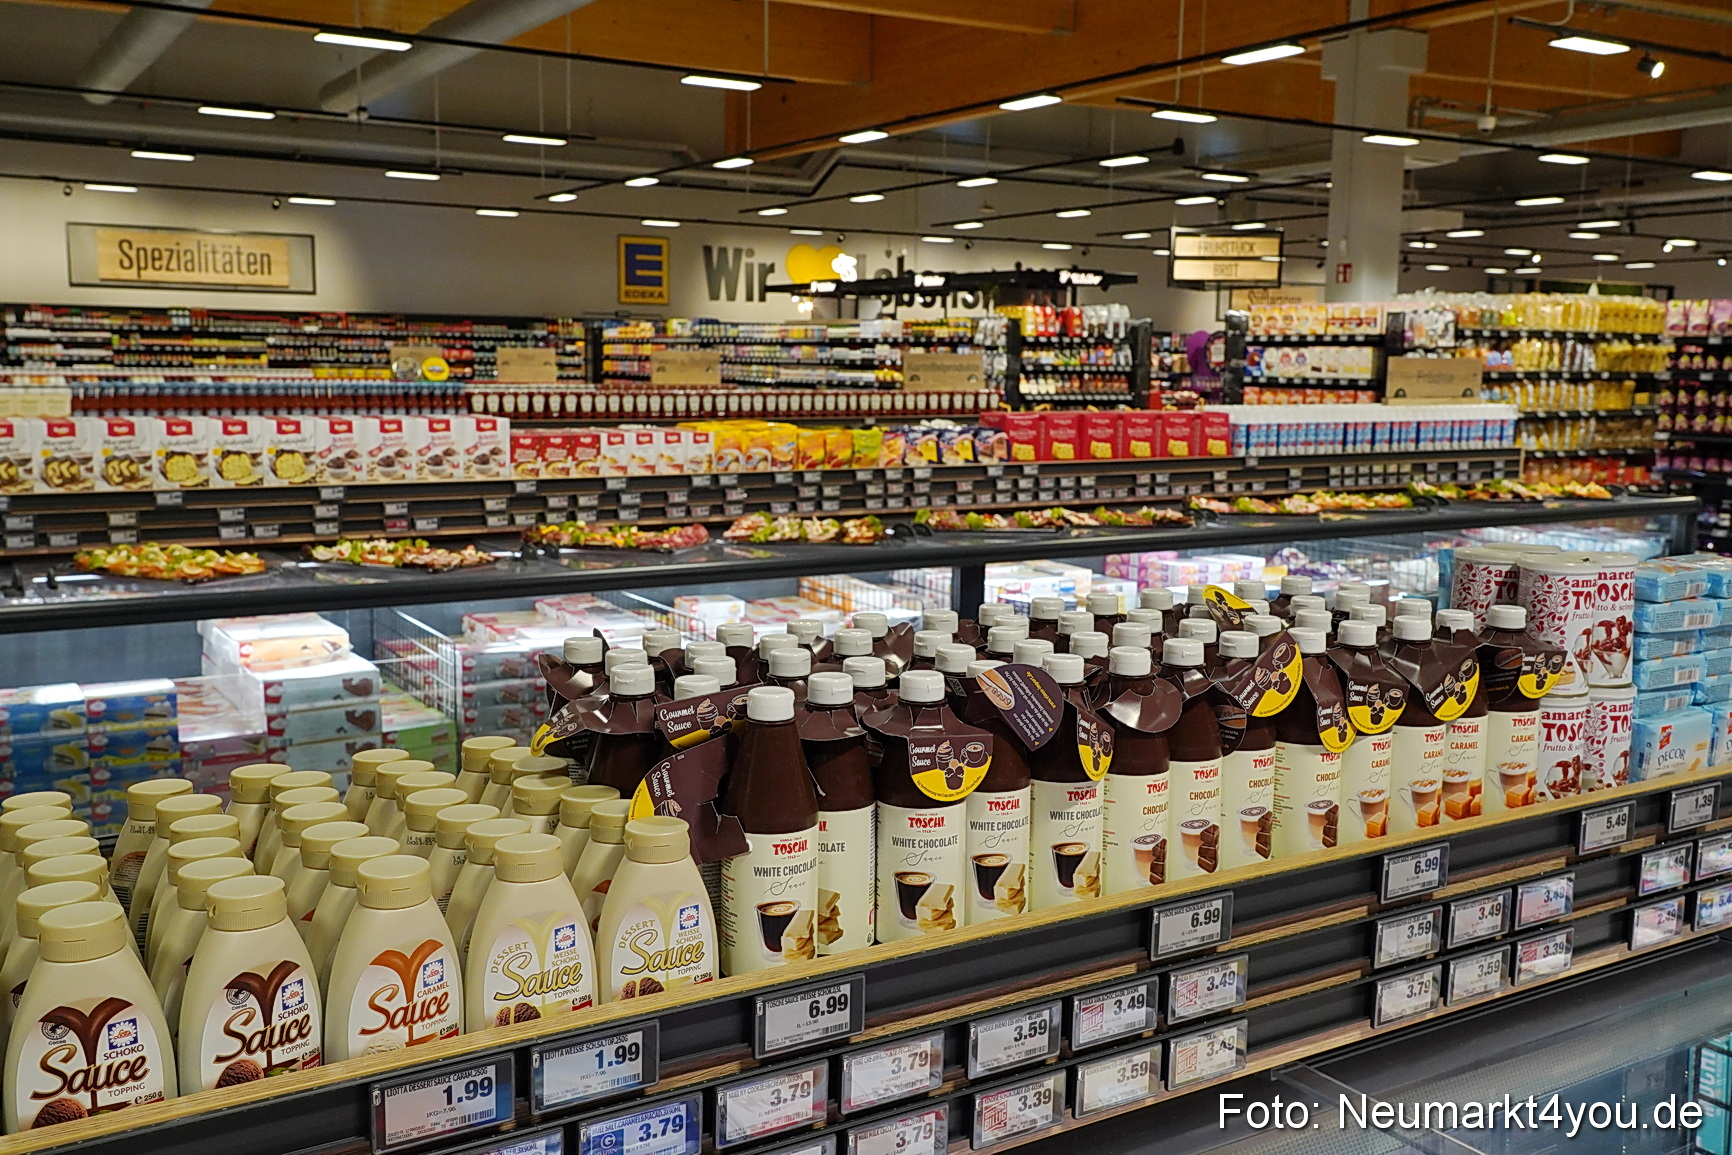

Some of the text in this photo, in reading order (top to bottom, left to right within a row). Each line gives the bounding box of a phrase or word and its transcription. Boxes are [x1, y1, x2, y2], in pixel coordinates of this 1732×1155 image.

[118, 238, 272, 279] Spezialitäten
[703, 245, 775, 302] Wir
[624, 289, 665, 300] EDEKA
[659, 704, 697, 721] Gourmet
[666, 720, 692, 734] Sauce
[1450, 724, 1480, 735] TOSCHI
[1511, 716, 1537, 728] TOSCHI
[1449, 741, 1479, 750] CARAMEL
[1510, 733, 1536, 743] CARAMEL
[909, 742, 937, 755] Gourmet
[1543, 742, 1573, 753] frutto &
[911, 755, 932, 767] Sauce
[1657, 747, 1686, 767] DECOR
[660, 761, 676, 799] Gourmet
[1192, 766, 1219, 781] TOSCHI
[650, 770, 662, 798] Sauce
[1066, 787, 1098, 802] TOSCHI
[1189, 786, 1220, 801] CHOCOLATE
[1694, 793, 1713, 810] 1.39
[986, 798, 1021, 812] TOSCHI
[907, 816, 946, 829] TOSCHI
[969, 815, 1029, 832] WHITE CHOCOLATE
[1049, 810, 1075, 821] WHITE
[1605, 812, 1627, 830] 5.49
[772, 839, 809, 856] TOSCHI
[891, 834, 959, 849] WHITE CHOCOLATE
[753, 856, 818, 878] WHITE CHOCOLATE
[1413, 856, 1439, 875] 6.99
[1190, 907, 1221, 929] 6.99
[1478, 902, 1502, 921] 3.49
[1656, 908, 1677, 926] 2.49
[618, 919, 656, 949] DESSERT
[677, 927, 701, 938] WEISSE
[1406, 920, 1432, 940] 3.59
[675, 933, 703, 946] SCHOKO
[490, 941, 529, 974] DESSERT
[553, 947, 578, 959] WEISSE
[619, 928, 706, 976] Sauce
[1542, 941, 1566, 958] 3.39
[551, 954, 580, 968] SCHOKO
[676, 963, 702, 975] TOPPING
[1477, 959, 1501, 978] 3.59
[492, 951, 584, 1001] Sauce
[1206, 970, 1236, 992] 3.49
[416, 981, 450, 998] CARAMEL
[553, 985, 580, 999] TOPPING
[1406, 980, 1431, 999] 3.79
[357, 983, 451, 1036] Sauce
[767, 1000, 784, 1010] TOSCHI
[784, 996, 799, 1007] SAUCE
[799, 992, 817, 1002] WEISSE
[808, 993, 849, 1019] 6.99
[1113, 993, 1145, 1016] 3.49
[277, 1003, 309, 1021] SCHOKO
[421, 1015, 448, 1030] TOPPING
[1013, 1018, 1048, 1043] 3.59
[1082, 1011, 1104, 1034] BILLIG
[212, 1006, 313, 1065] Sauce
[103, 1044, 145, 1061] SCHOKO
[280, 1039, 310, 1056] TOPPING
[544, 1049, 565, 1061] LIOTTA
[565, 1043, 586, 1055] WEISSE
[594, 1041, 640, 1070] 1.99
[891, 1049, 929, 1075] 3.79
[29, 1043, 150, 1100] Sauce
[1117, 1060, 1149, 1084] 3.59
[107, 1082, 146, 1098] TOPPING
[144, 1090, 163, 1102] 250 g
[386, 1086, 409, 1098] LIOTTA
[408, 1080, 434, 1093] DESSERT
[433, 1076, 453, 1088] SAUCE
[442, 1076, 493, 1106] 1.99
[770, 1080, 812, 1108] 3.79
[1018, 1087, 1052, 1113] 3.39
[638, 1113, 685, 1143] 3.79
[984, 1109, 1008, 1131] BILLIG
[895, 1122, 934, 1149] 3.79
